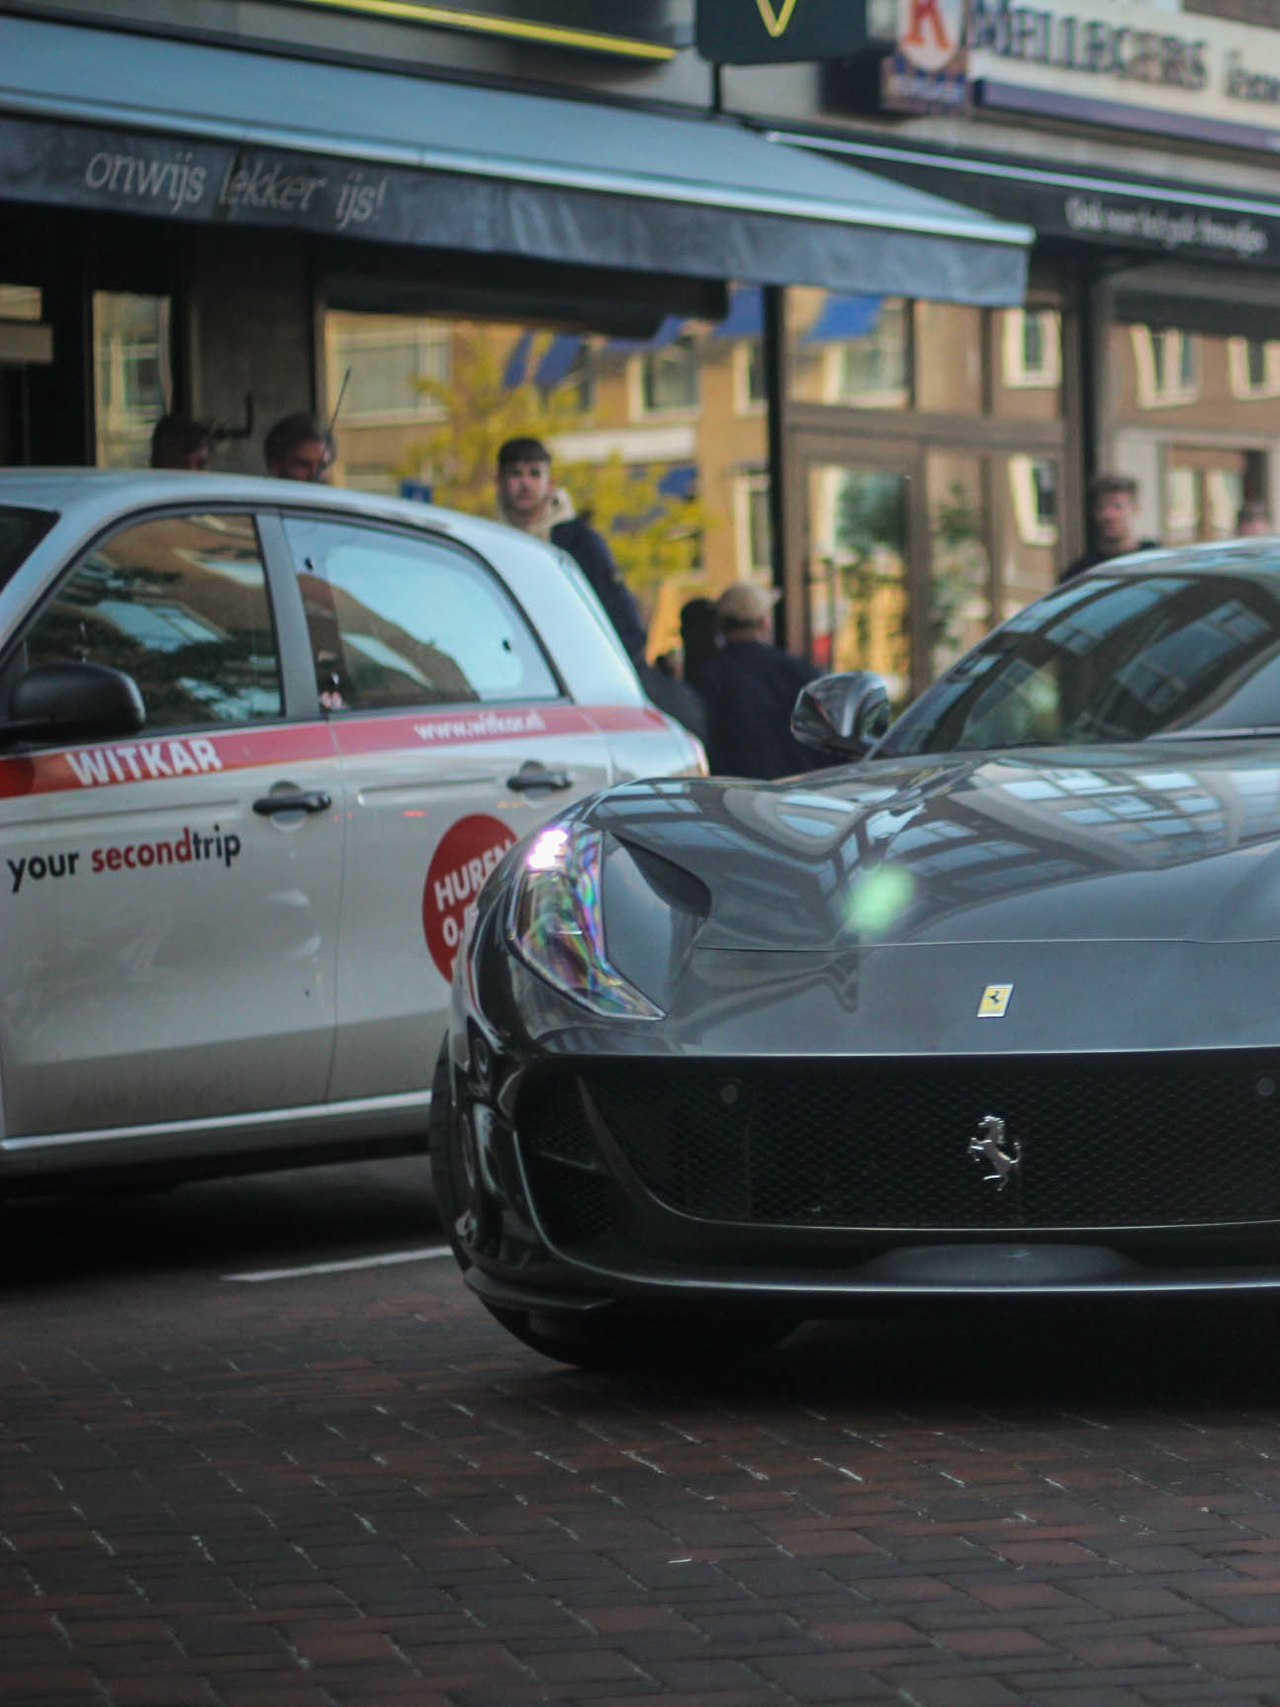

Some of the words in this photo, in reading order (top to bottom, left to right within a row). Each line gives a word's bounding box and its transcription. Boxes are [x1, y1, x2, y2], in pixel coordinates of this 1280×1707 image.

[86, 151, 207, 213] onwijs
[219, 158, 327, 213] lekker
[334, 171, 390, 232] ijs!
[65, 738, 223, 786] WITKAR
[7, 852, 80, 894] your
[91, 823, 242, 872] secondtrip
